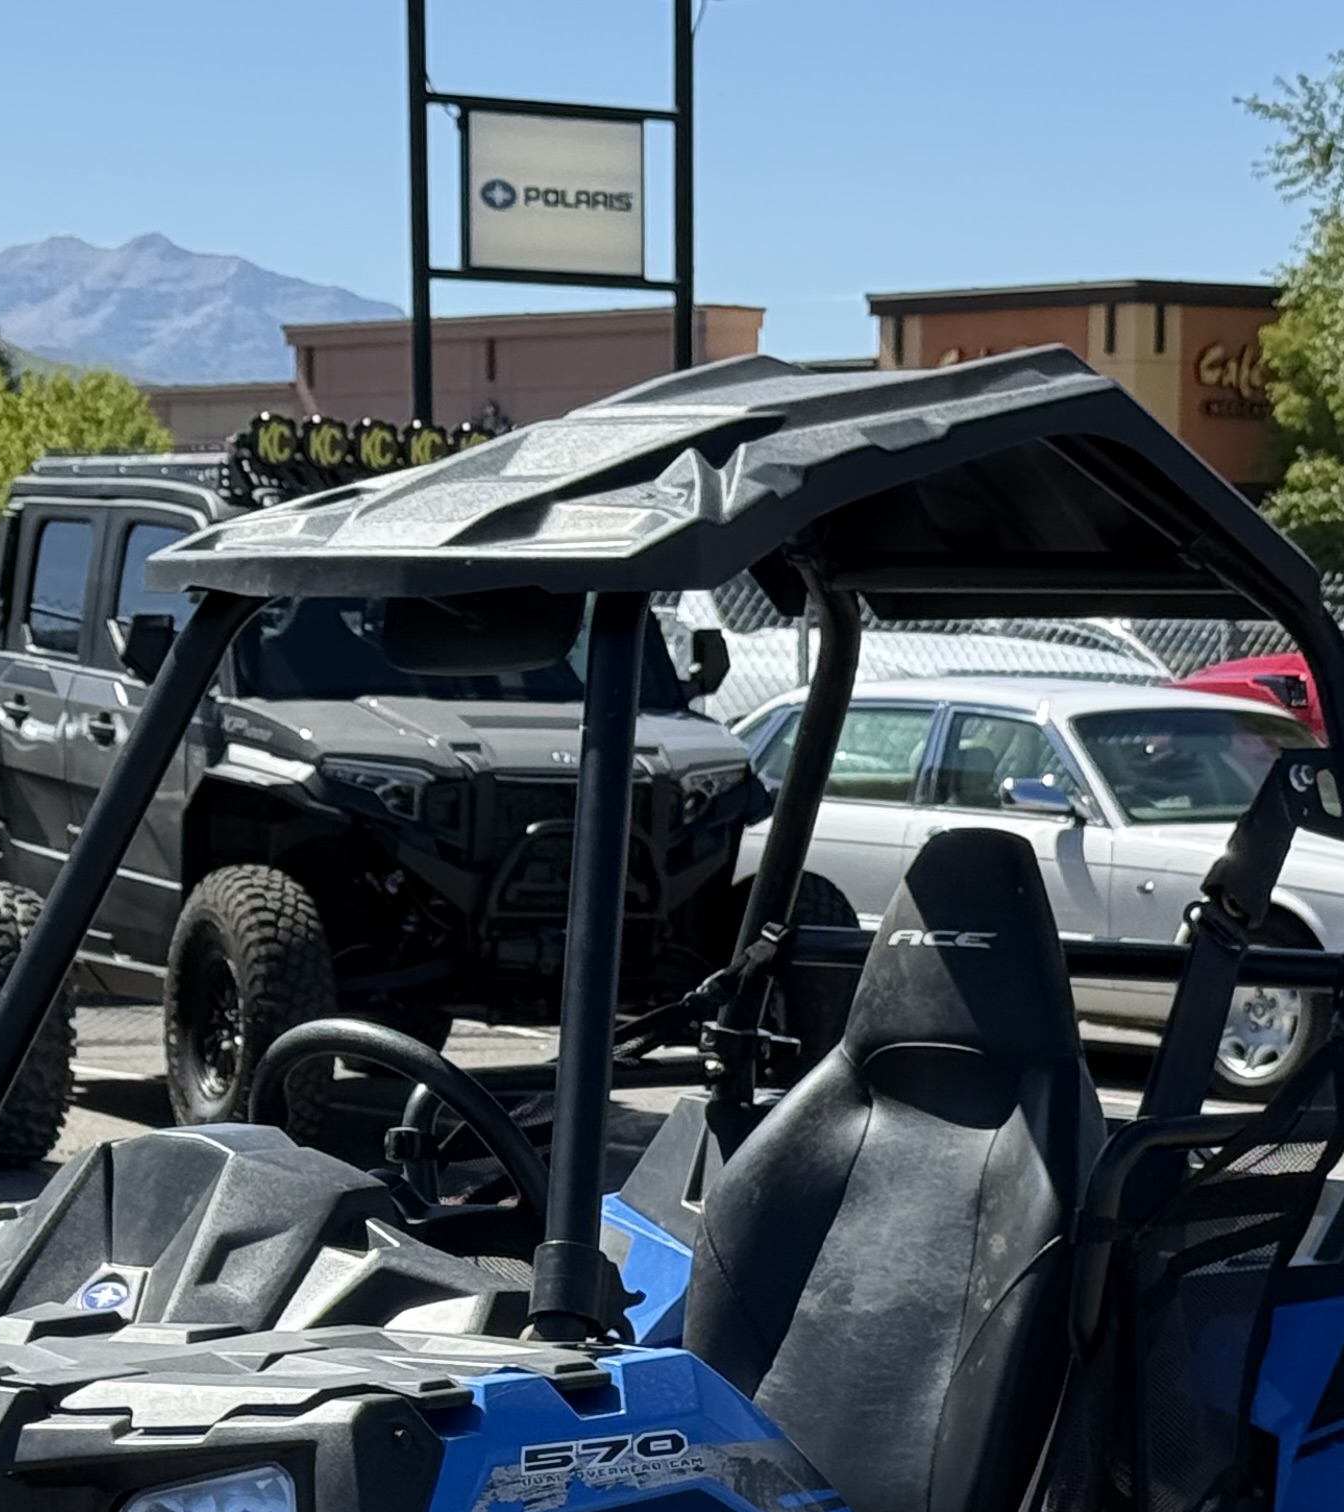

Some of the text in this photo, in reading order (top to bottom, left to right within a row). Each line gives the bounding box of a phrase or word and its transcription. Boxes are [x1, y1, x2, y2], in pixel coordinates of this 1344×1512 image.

[524, 186, 633, 212] POLARIS
[258, 422, 291, 464] KC
[309, 424, 343, 467] KC
[360, 428, 394, 469] KC
[887, 929, 998, 949] ACE
[520, 1429, 689, 1475] 570
[668, 1457, 704, 1469] CAM
